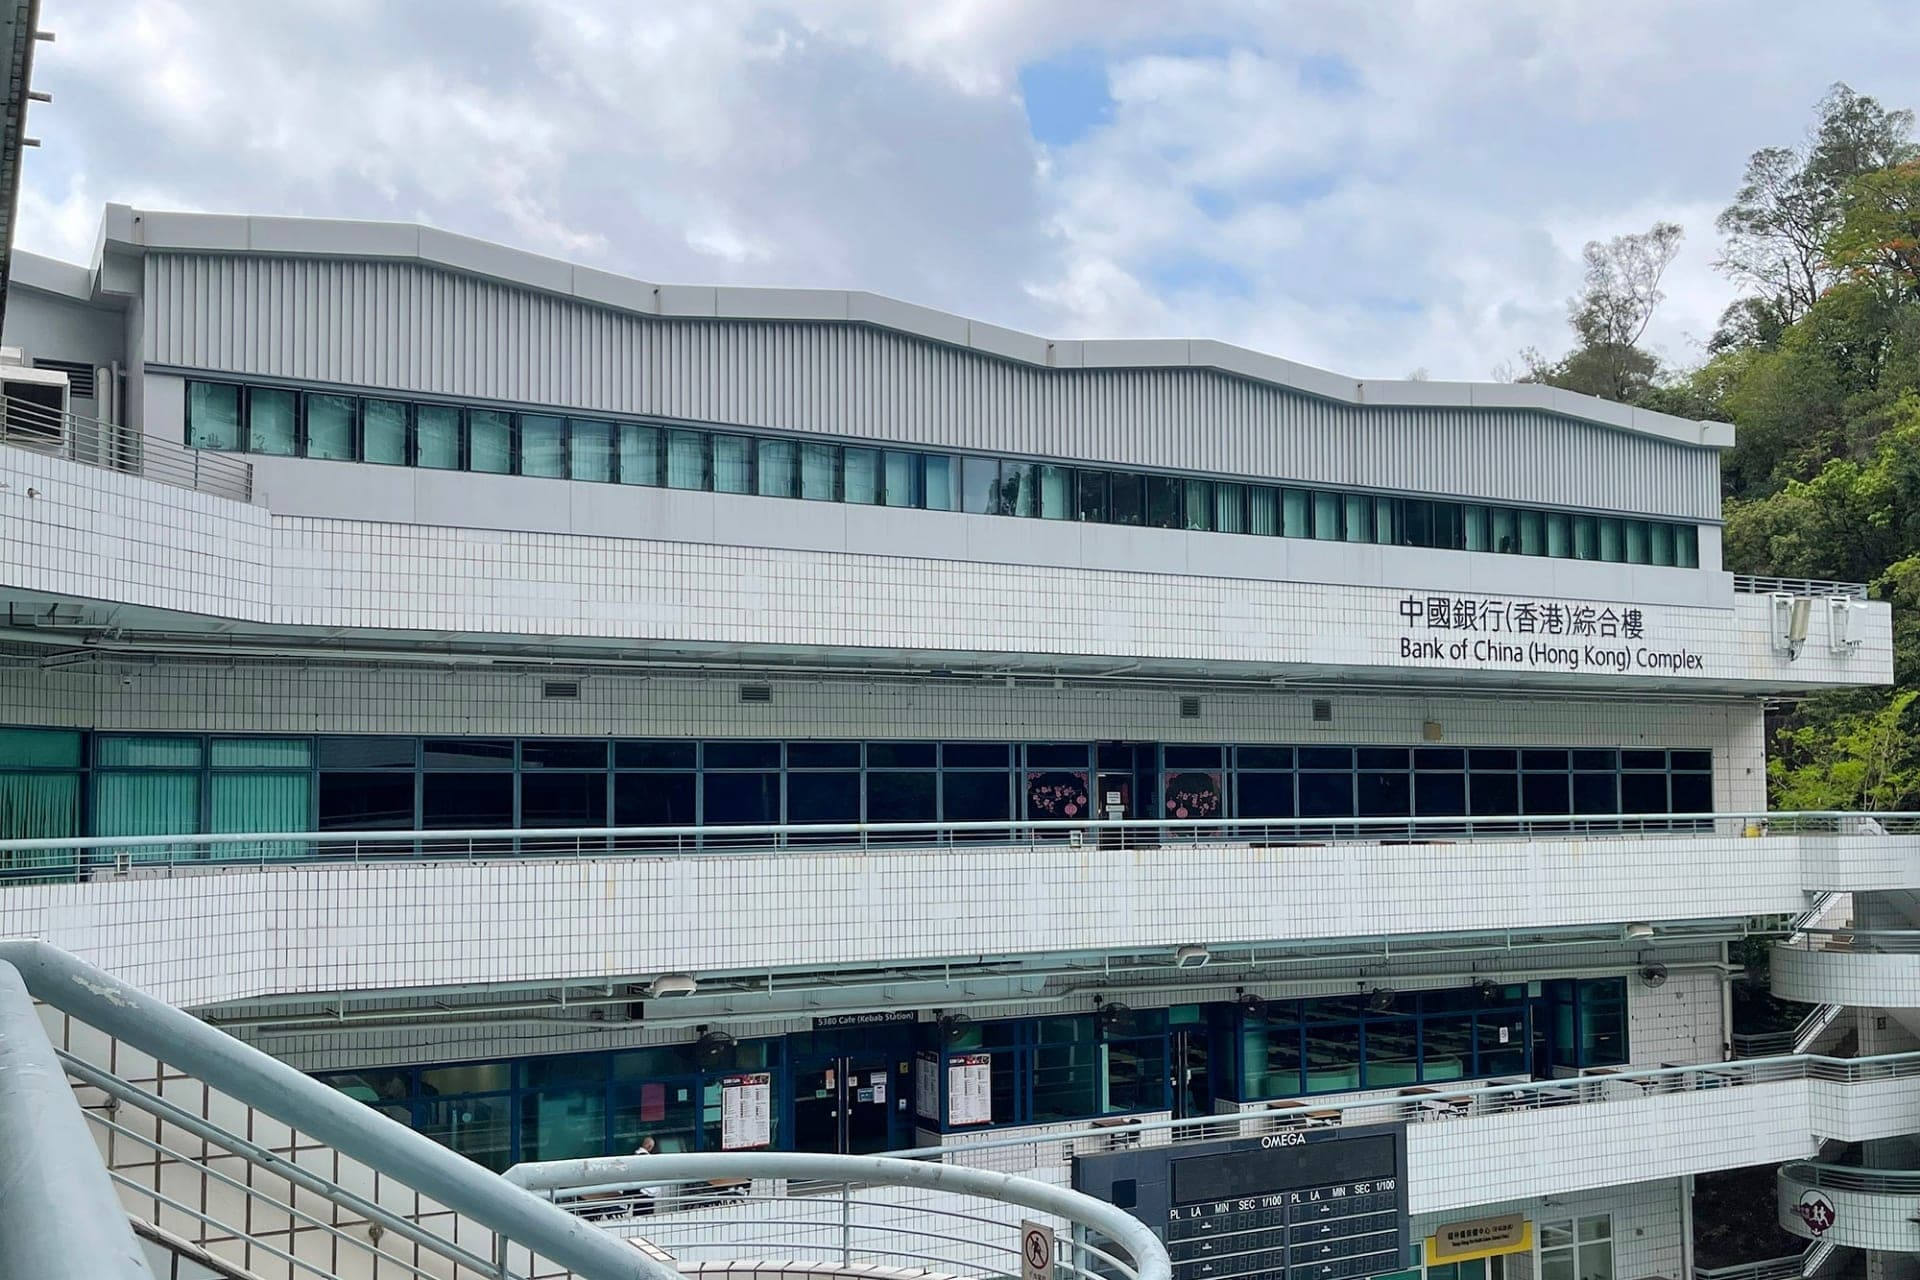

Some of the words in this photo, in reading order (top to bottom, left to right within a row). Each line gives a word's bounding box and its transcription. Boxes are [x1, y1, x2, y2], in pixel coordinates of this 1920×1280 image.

[1399, 594, 1645, 640] 中國銀行(香港)綜合樓
[1400, 637, 1444, 660] Bank
[1449, 638, 1468, 660] of
[1473, 639, 1524, 662] China
[1528, 641, 1579, 669] (Hong
[1584, 644, 1631, 671] Kong)
[1636, 647, 1704, 673] Complex
[818, 1017, 837, 1026] 5380
[857, 1013, 884, 1024] (Kebab
[885, 1011, 914, 1021] Station)
[1261, 1133, 1306, 1149] OMEGA
[1291, 1192, 1301, 1204] PL
[1310, 1190, 1320, 1201] LA
[1332, 1186, 1346, 1197] MIN
[1354, 1183, 1371, 1194] SEC
[1376, 1179, 1395, 1191] 1/100
[1170, 1208, 1180, 1220] PL
[1190, 1206, 1202, 1218] LA
[1214, 1202, 1230, 1213] MIN
[1238, 1199, 1256, 1211] SEC
[1262, 1195, 1282, 1207] 1/100
